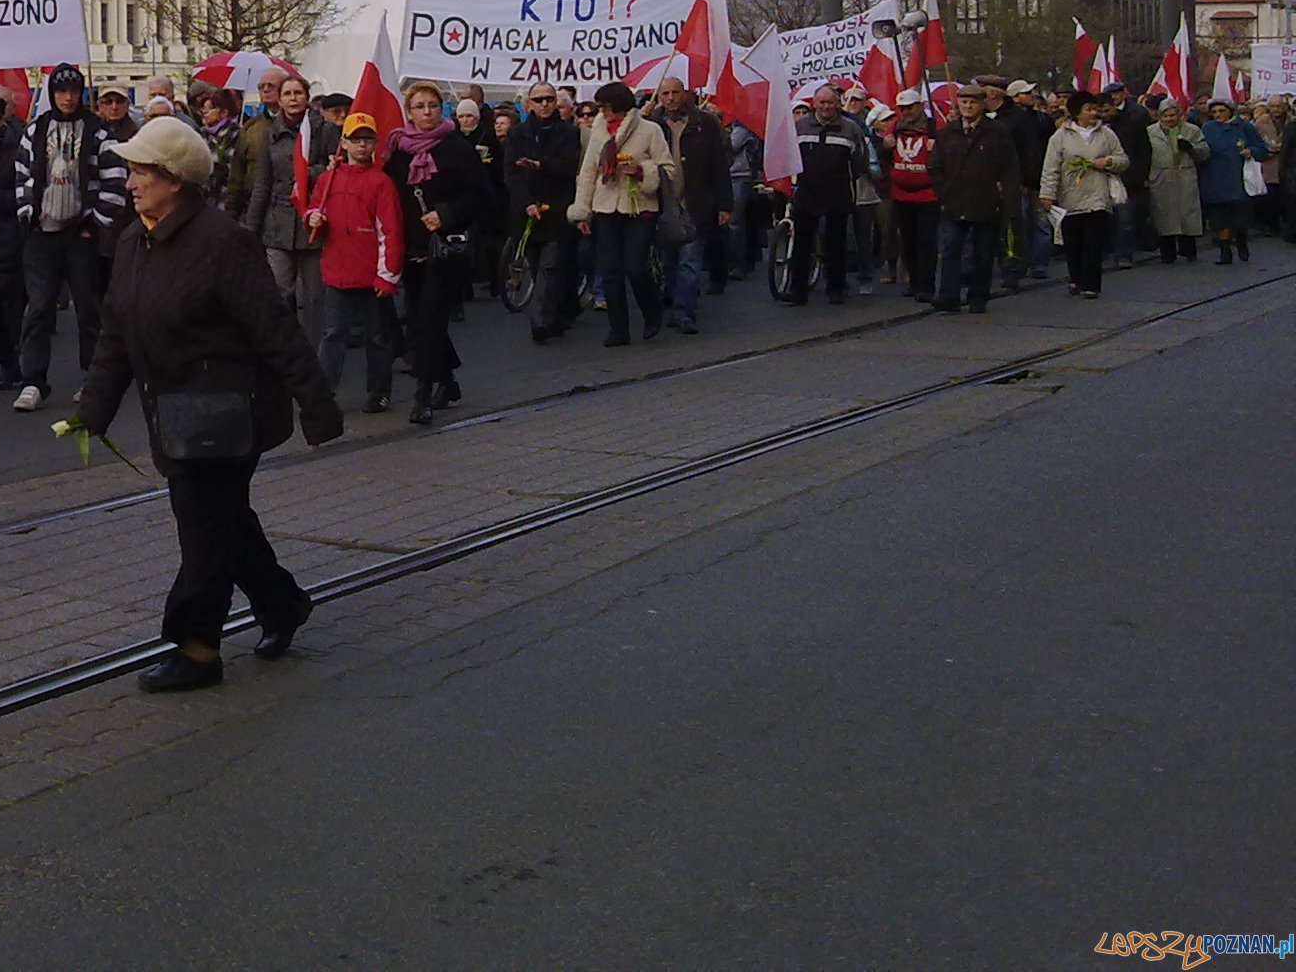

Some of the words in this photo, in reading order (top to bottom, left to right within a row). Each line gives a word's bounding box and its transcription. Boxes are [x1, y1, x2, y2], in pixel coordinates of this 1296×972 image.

[409, 12, 549, 56] POMAGAŁ
[571, 20, 685, 53] ROSJANO
[471, 56, 491, 80] W
[509, 55, 631, 82] ZAMACHU
[791, 49, 870, 76] SMOLEŃS
